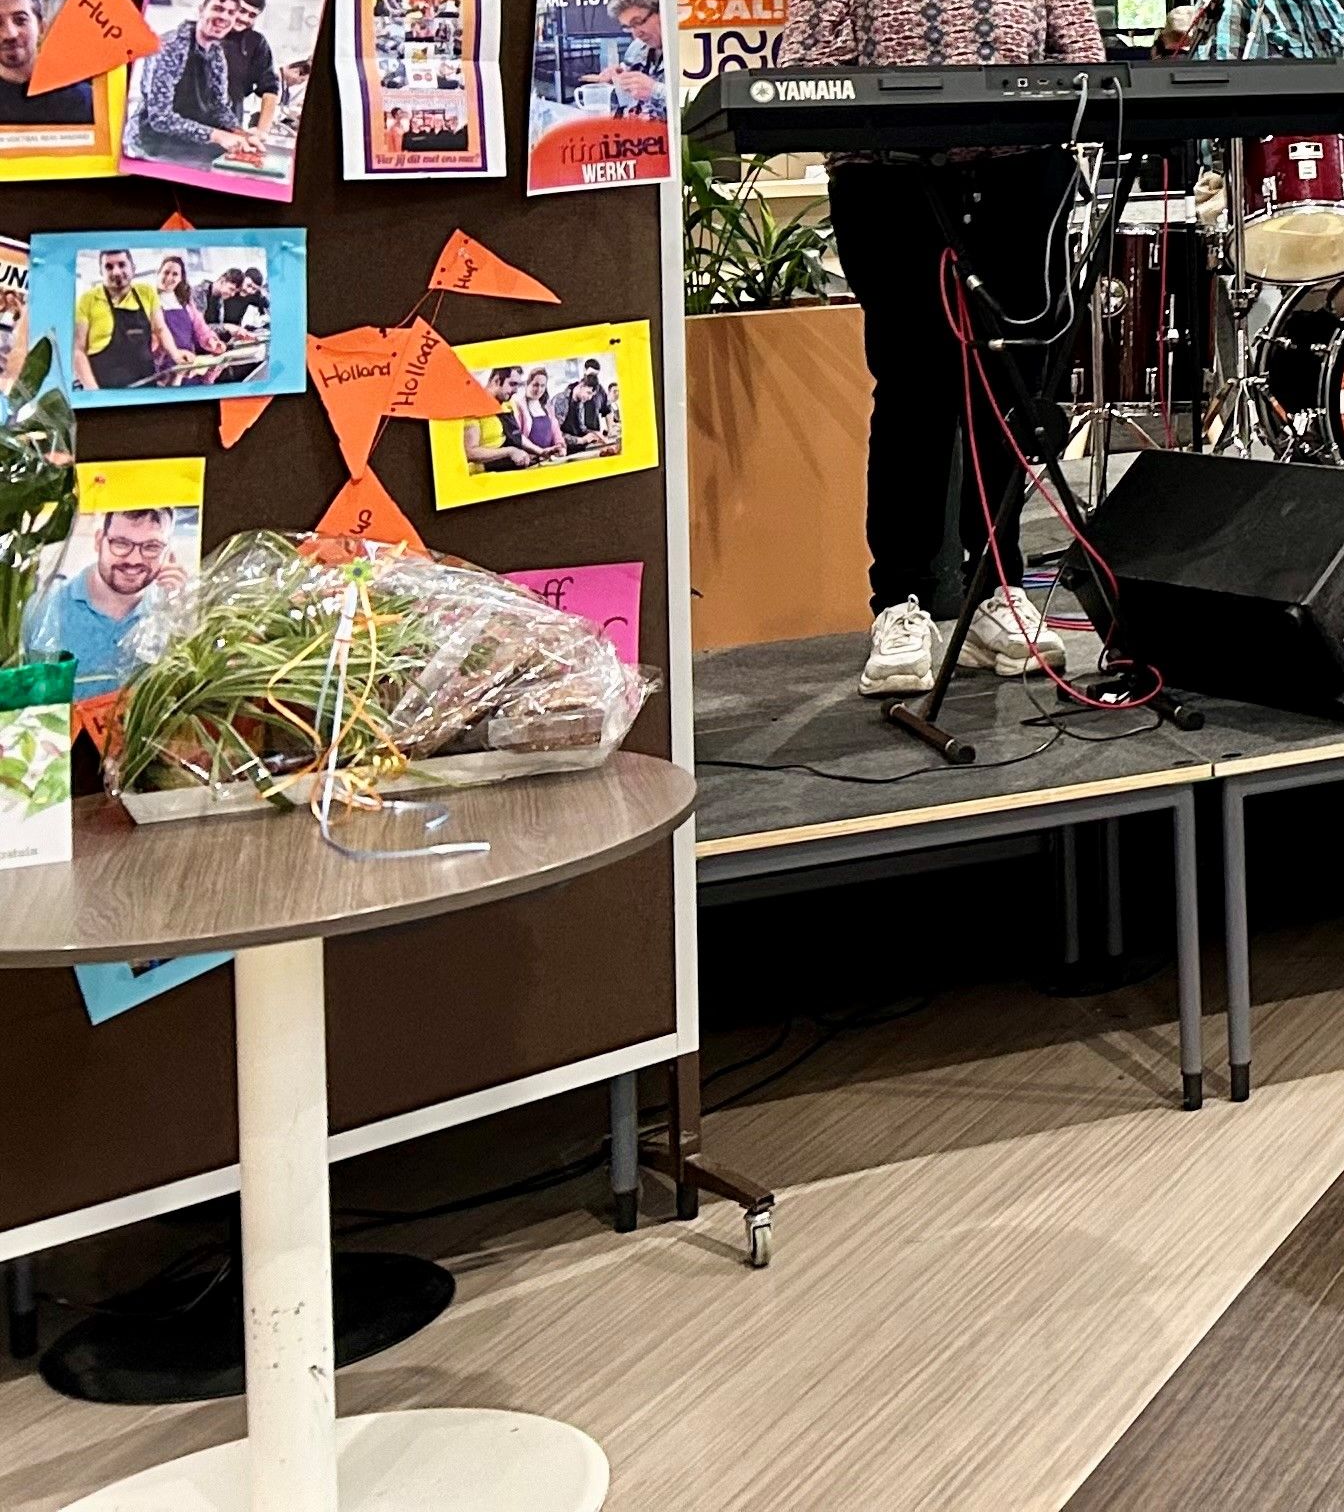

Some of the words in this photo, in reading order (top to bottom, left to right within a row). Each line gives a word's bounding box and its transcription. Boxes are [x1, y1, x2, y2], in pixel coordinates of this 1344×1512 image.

[774, 79, 857, 101] YAMAHA
[581, 159, 638, 184] WERKT
[452, 257, 479, 290] Hup
[317, 361, 392, 388] Holland
[391, 334, 442, 406] Holland
